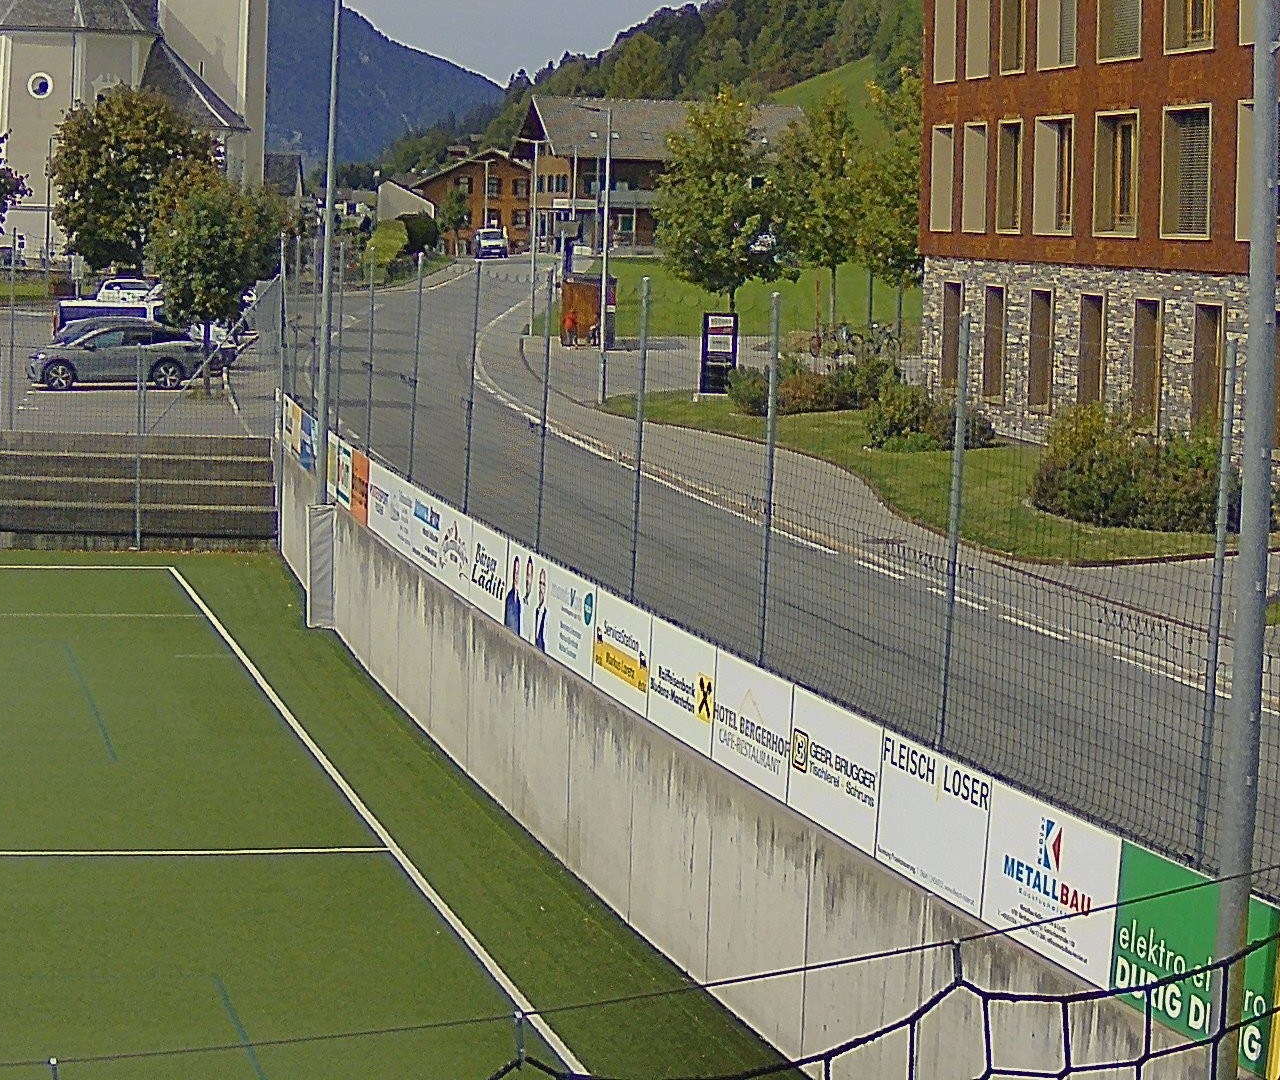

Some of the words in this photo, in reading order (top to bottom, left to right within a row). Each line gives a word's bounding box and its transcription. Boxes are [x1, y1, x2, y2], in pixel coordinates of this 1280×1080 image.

[740, 716, 791, 759] BERGERHOF
[835, 754, 876, 791] BRUGGER
[883, 736, 936, 785] FLEISCH
[943, 764, 990, 811] LOSER
[1003, 854, 1092, 917] METALLBAU
[1119, 919, 1186, 983] elektro
